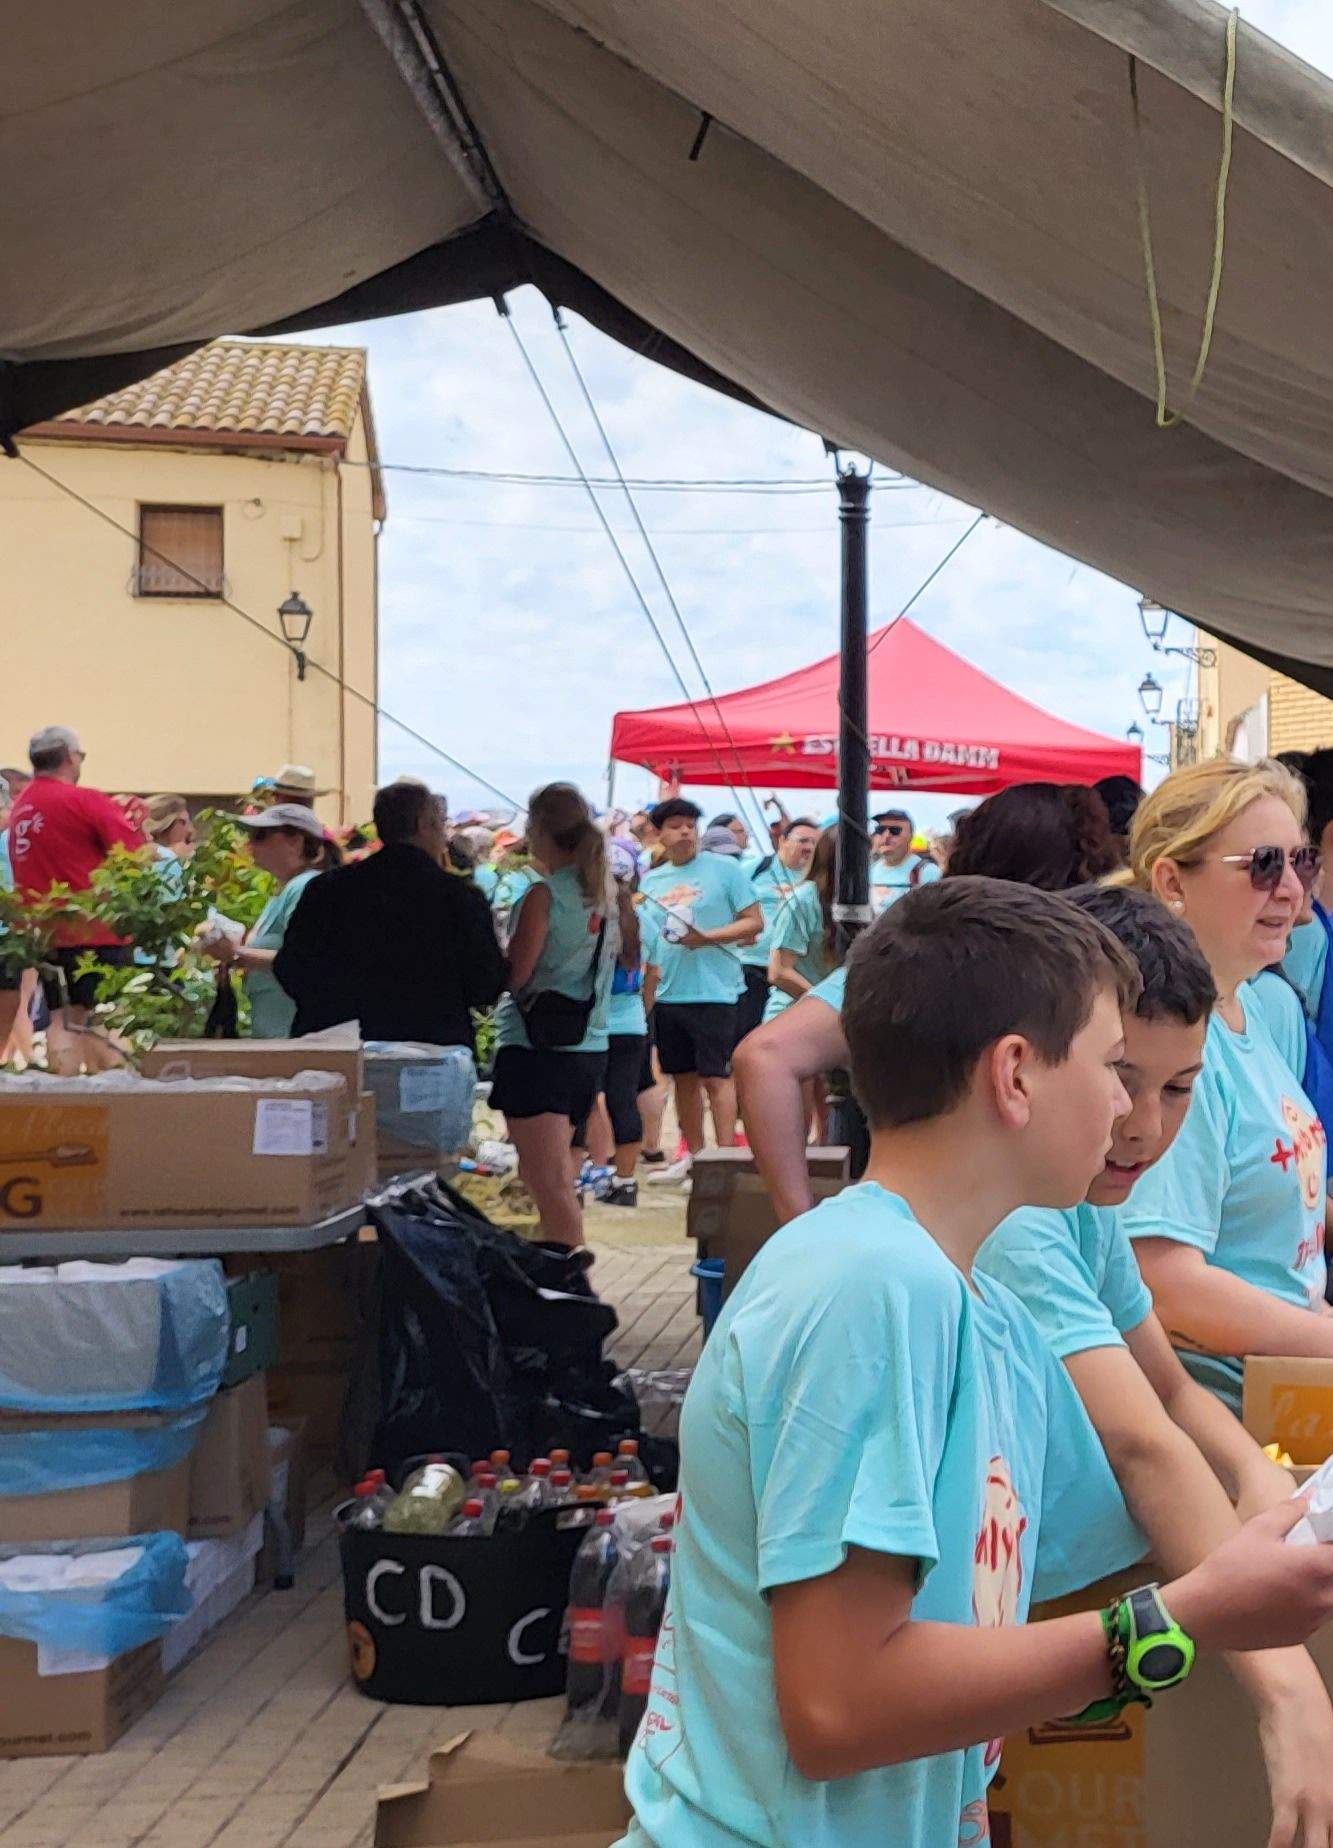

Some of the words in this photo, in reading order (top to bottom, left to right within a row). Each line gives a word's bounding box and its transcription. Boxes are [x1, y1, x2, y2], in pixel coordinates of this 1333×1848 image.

[802, 735, 920, 761] ESELLA
[922, 737, 1000, 769] DAMM
[366, 1558, 466, 1630] CD
